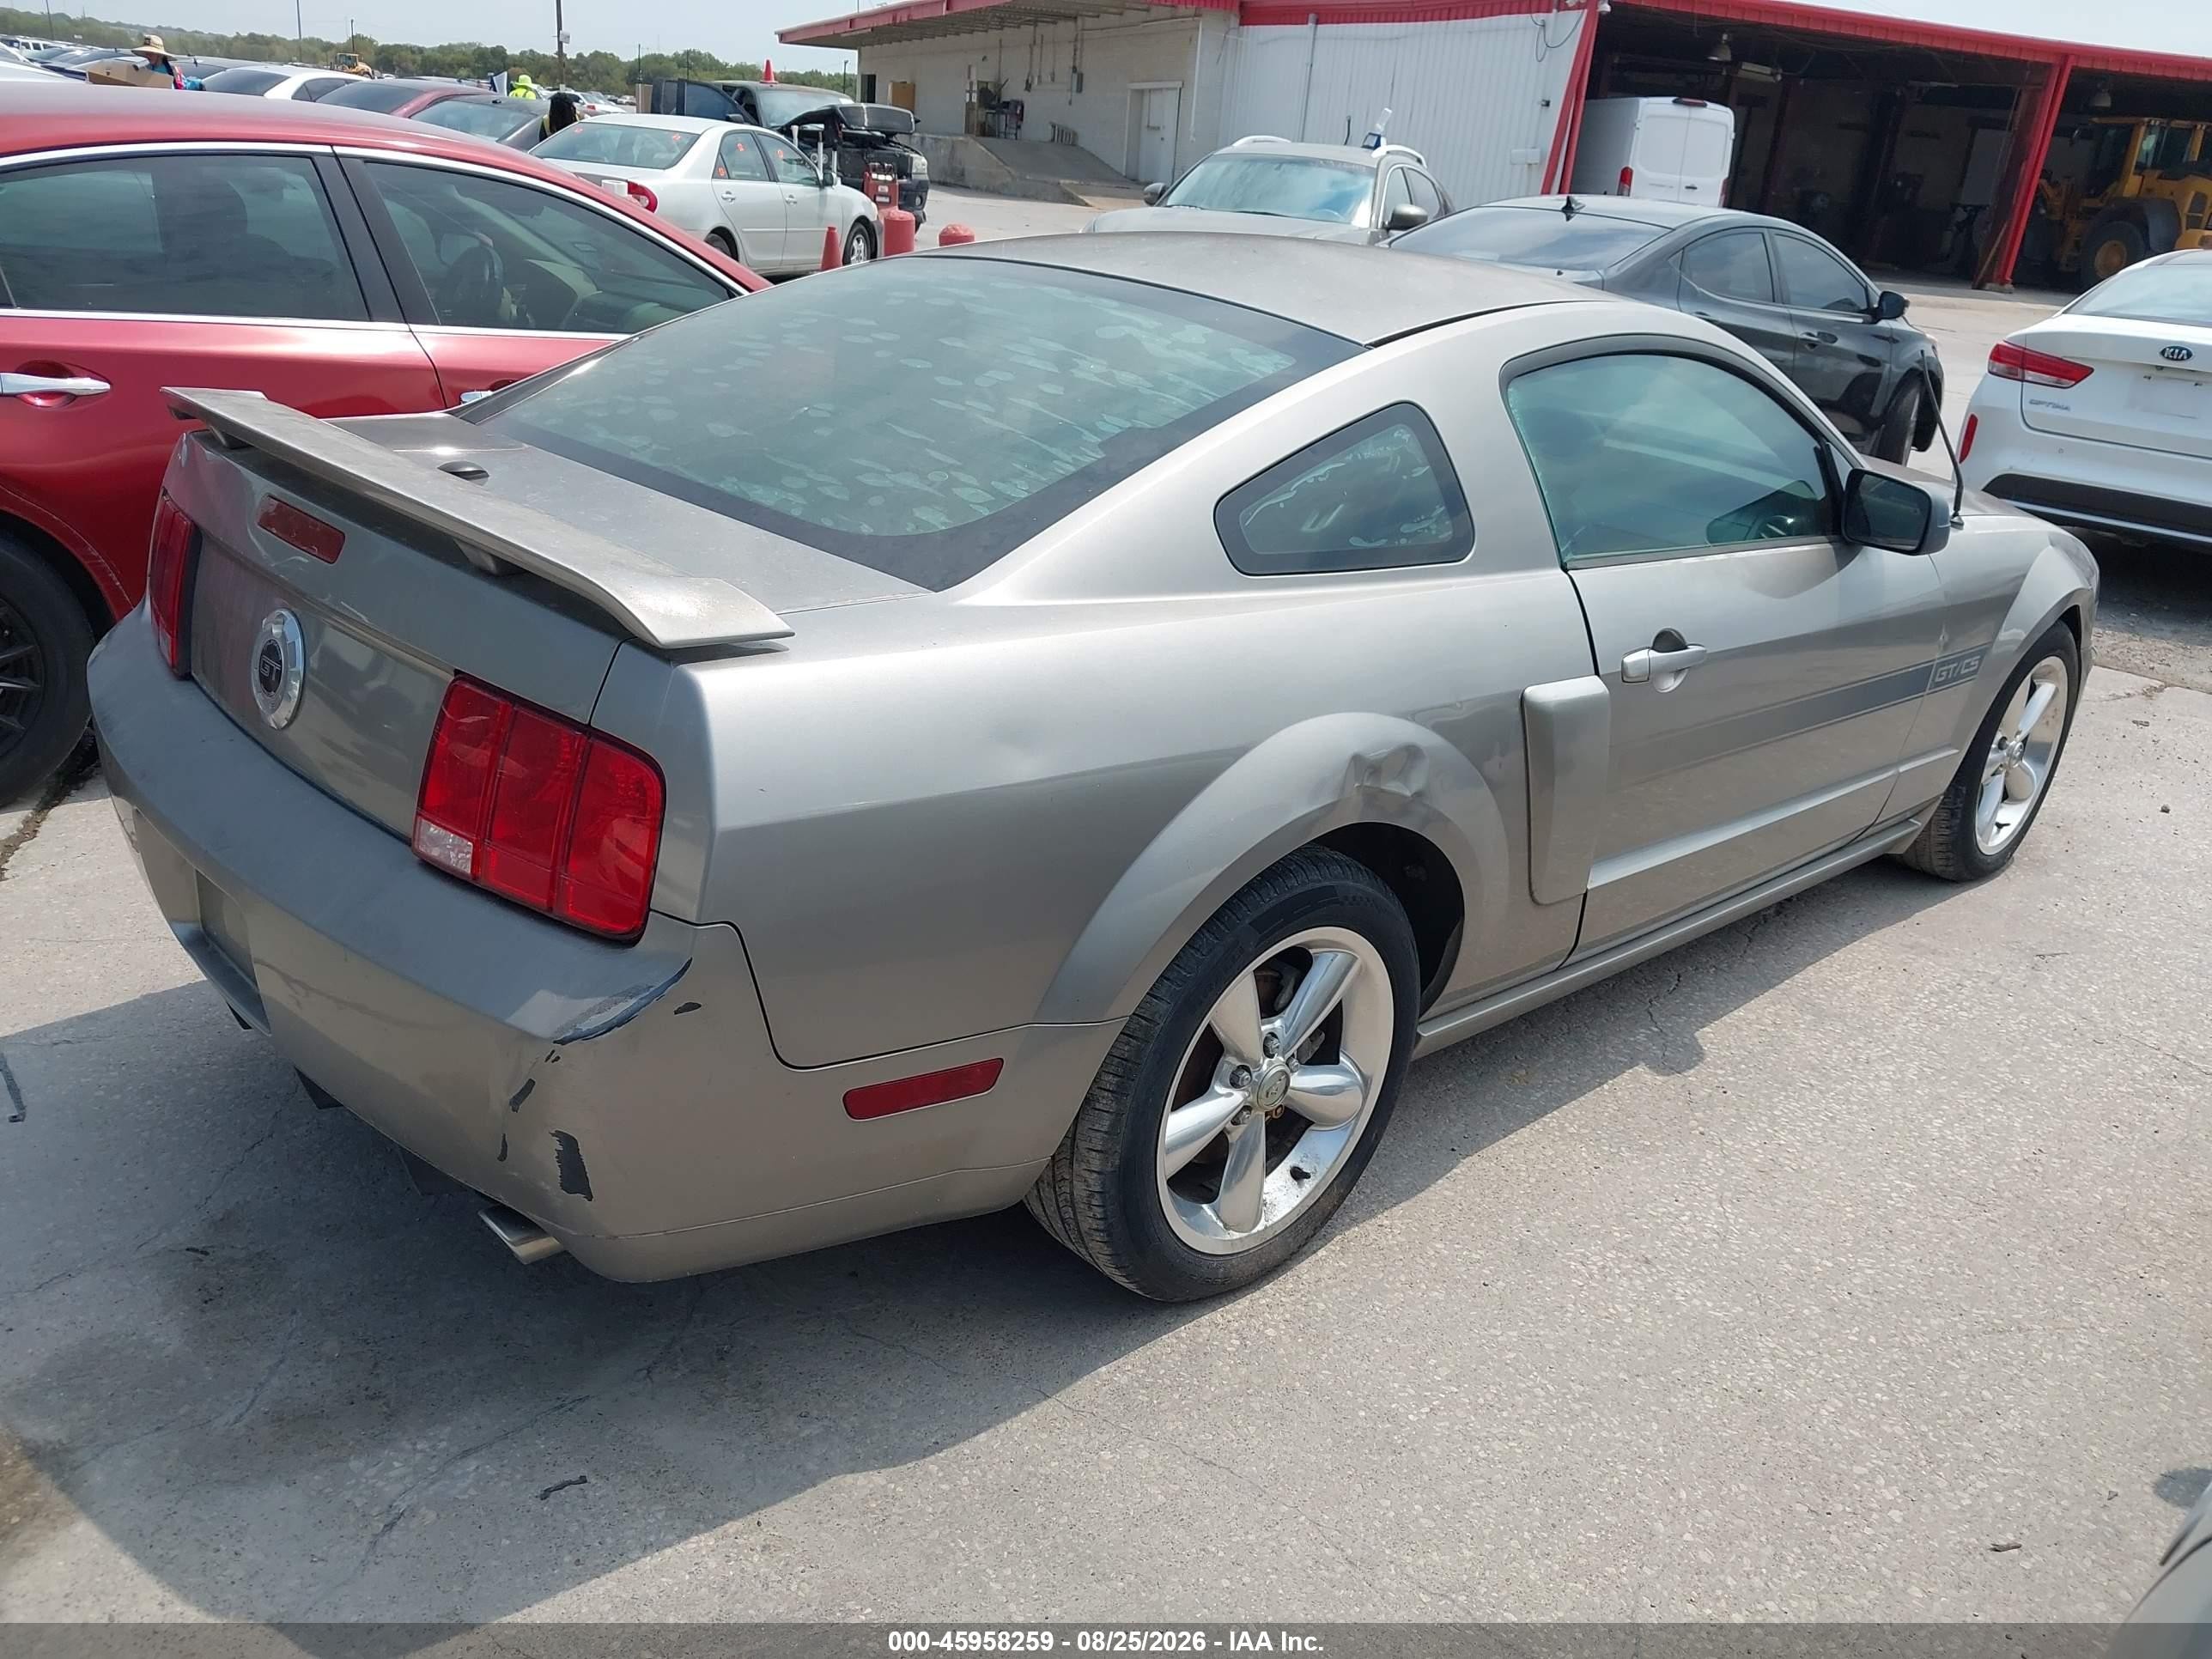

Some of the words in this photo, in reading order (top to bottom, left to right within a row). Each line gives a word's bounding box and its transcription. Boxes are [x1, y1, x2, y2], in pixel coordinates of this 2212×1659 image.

[2163, 348, 2187, 360] KIA
[260, 654, 282, 680] GT
[1935, 655, 1981, 683] GT/CS
